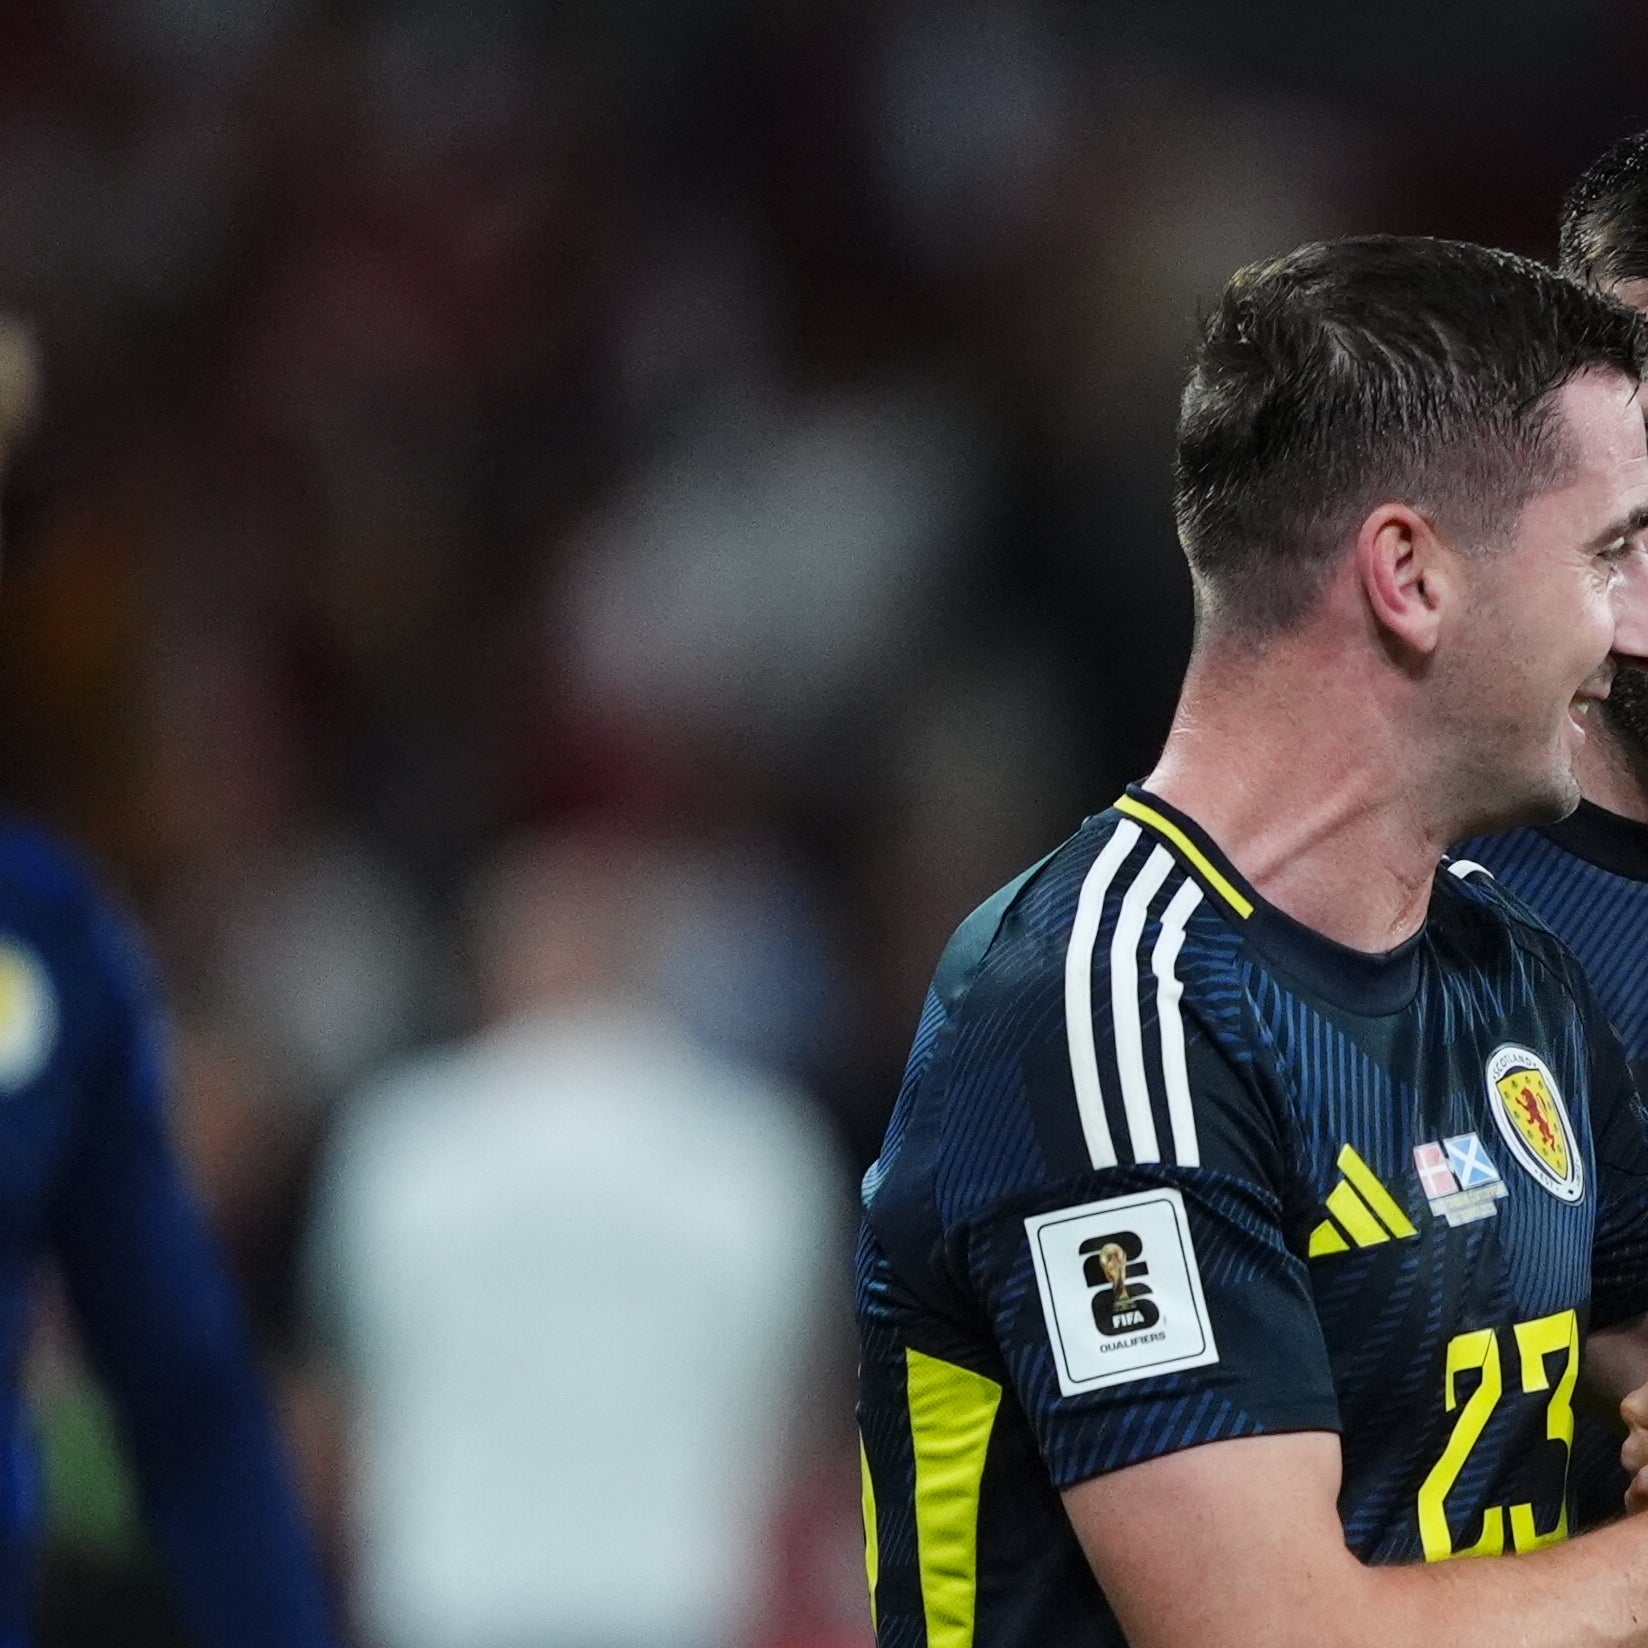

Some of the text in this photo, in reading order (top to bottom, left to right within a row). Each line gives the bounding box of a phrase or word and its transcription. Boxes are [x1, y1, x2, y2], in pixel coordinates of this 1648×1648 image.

[1494, 1053, 1532, 1078] SCOTLAND
[1112, 1310, 1145, 1329] FIFA
[1100, 1331, 1166, 1354] QUALIFIERS
[1417, 1309, 1579, 1562] 23
